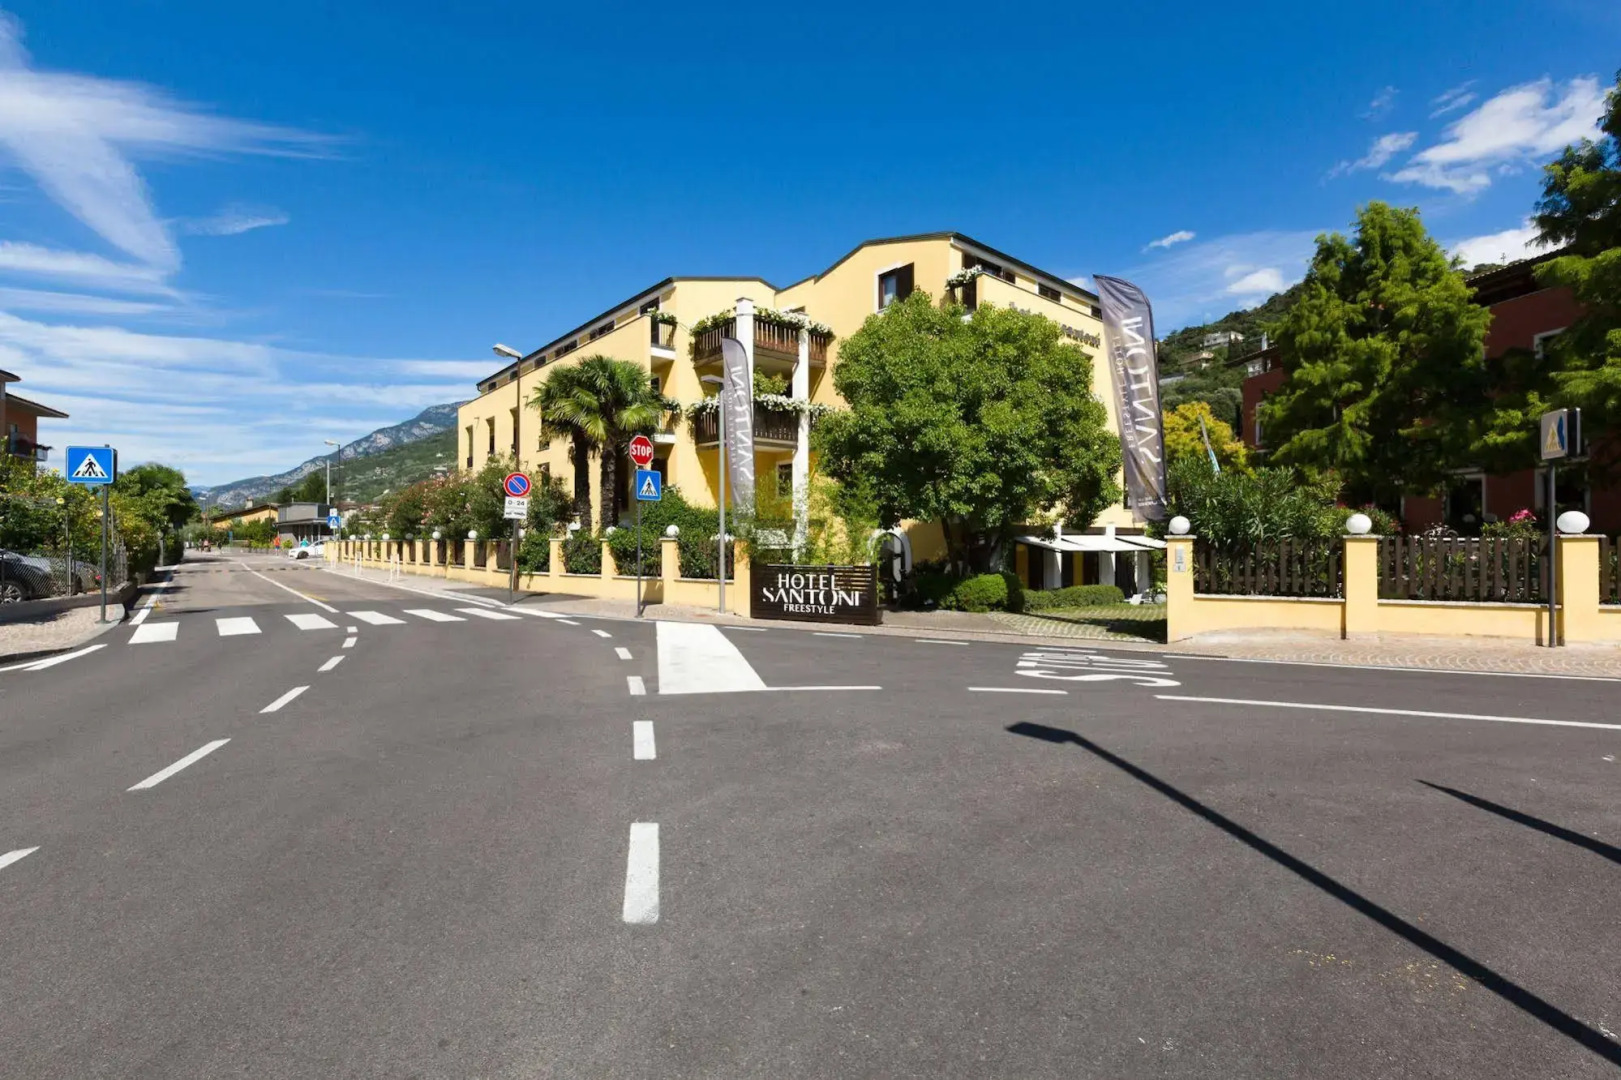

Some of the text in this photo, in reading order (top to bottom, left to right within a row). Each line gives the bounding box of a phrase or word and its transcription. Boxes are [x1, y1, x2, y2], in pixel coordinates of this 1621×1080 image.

[631, 445, 652, 457] STOP
[778, 573, 840, 591] HOTEL
[762, 587, 860, 606] SANTONI
[784, 604, 835, 614] FREESTYLE
